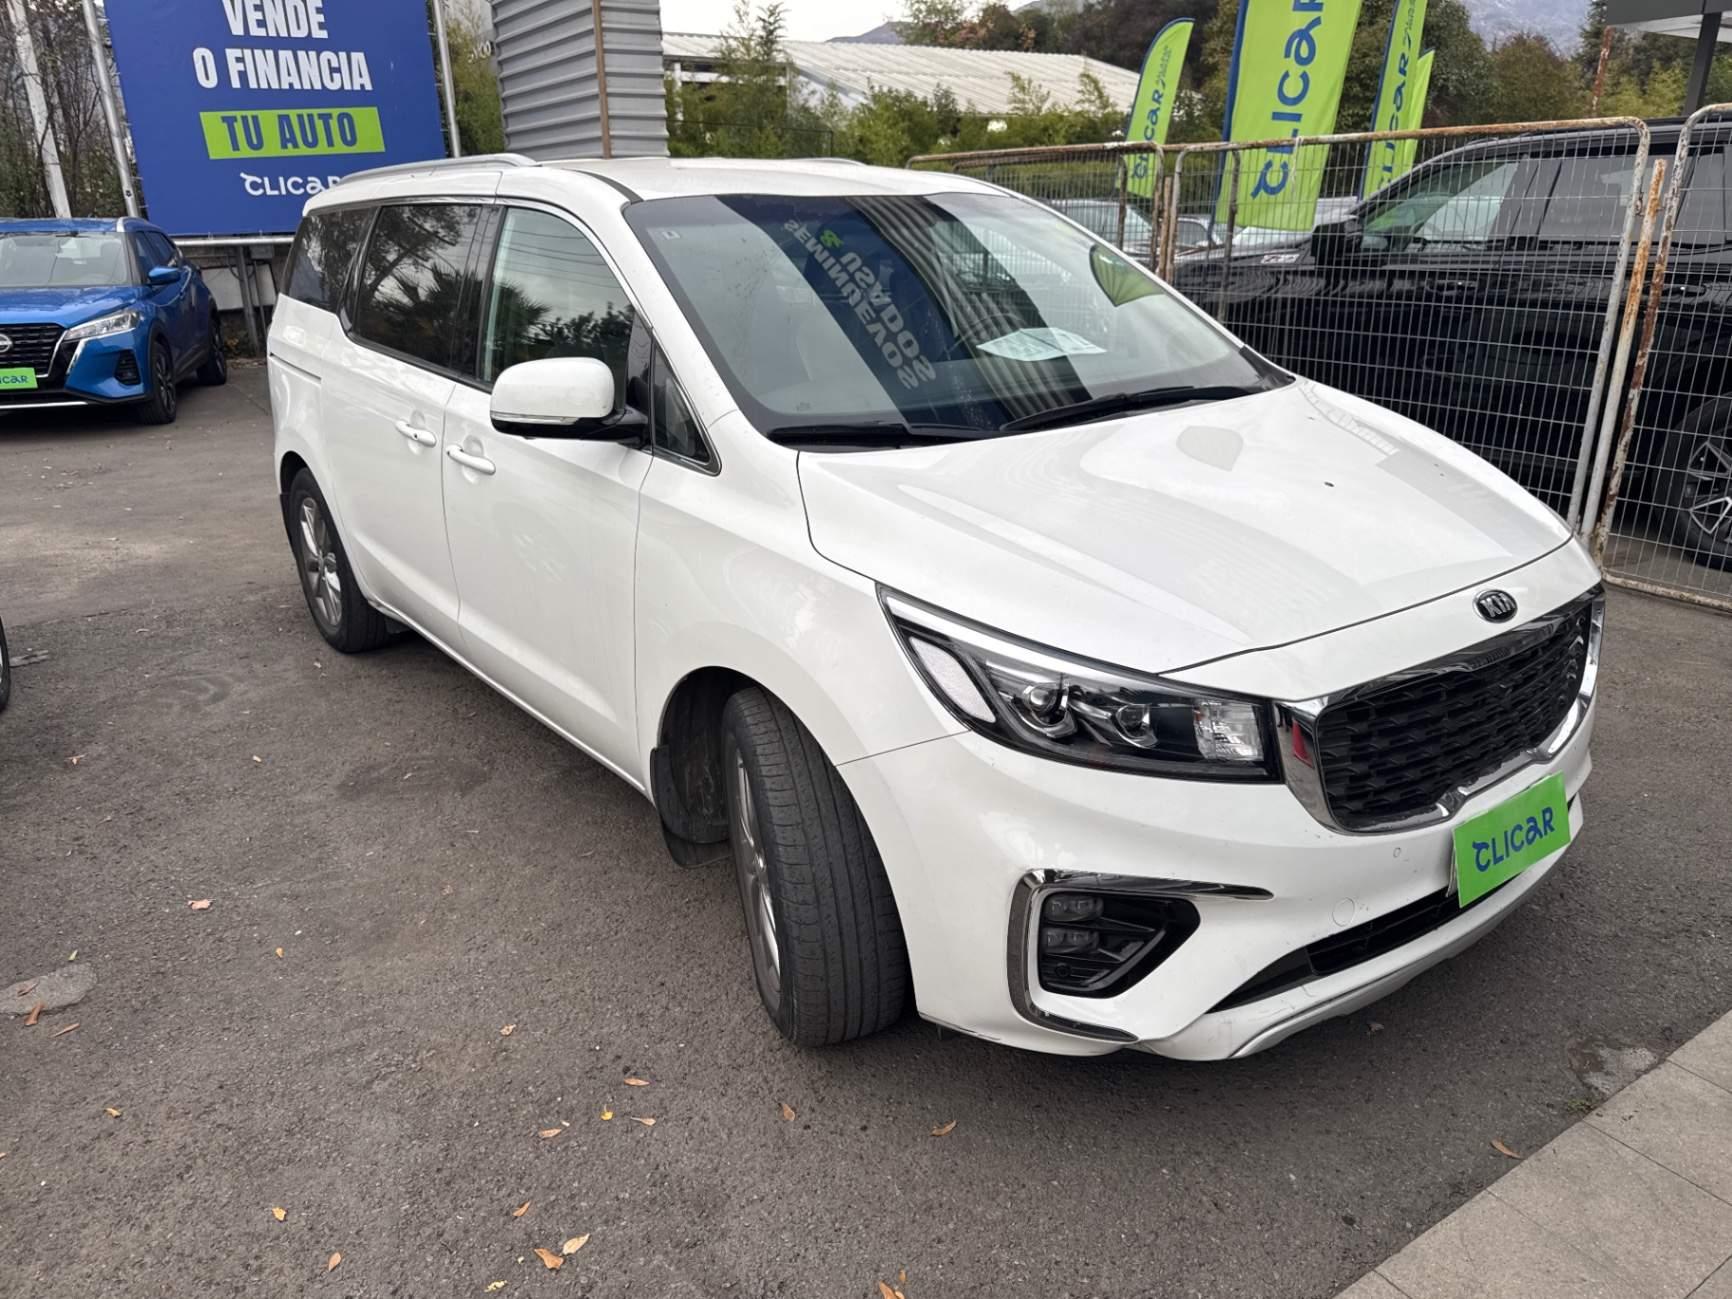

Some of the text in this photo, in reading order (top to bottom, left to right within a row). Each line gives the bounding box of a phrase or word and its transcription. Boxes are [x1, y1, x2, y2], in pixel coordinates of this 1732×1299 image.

[221, 0, 329, 39] VENDE
[192, 47, 373, 91] O FINANCIA
[221, 112, 358, 152] TU AUTO
[1479, 592, 1516, 618] KIA
